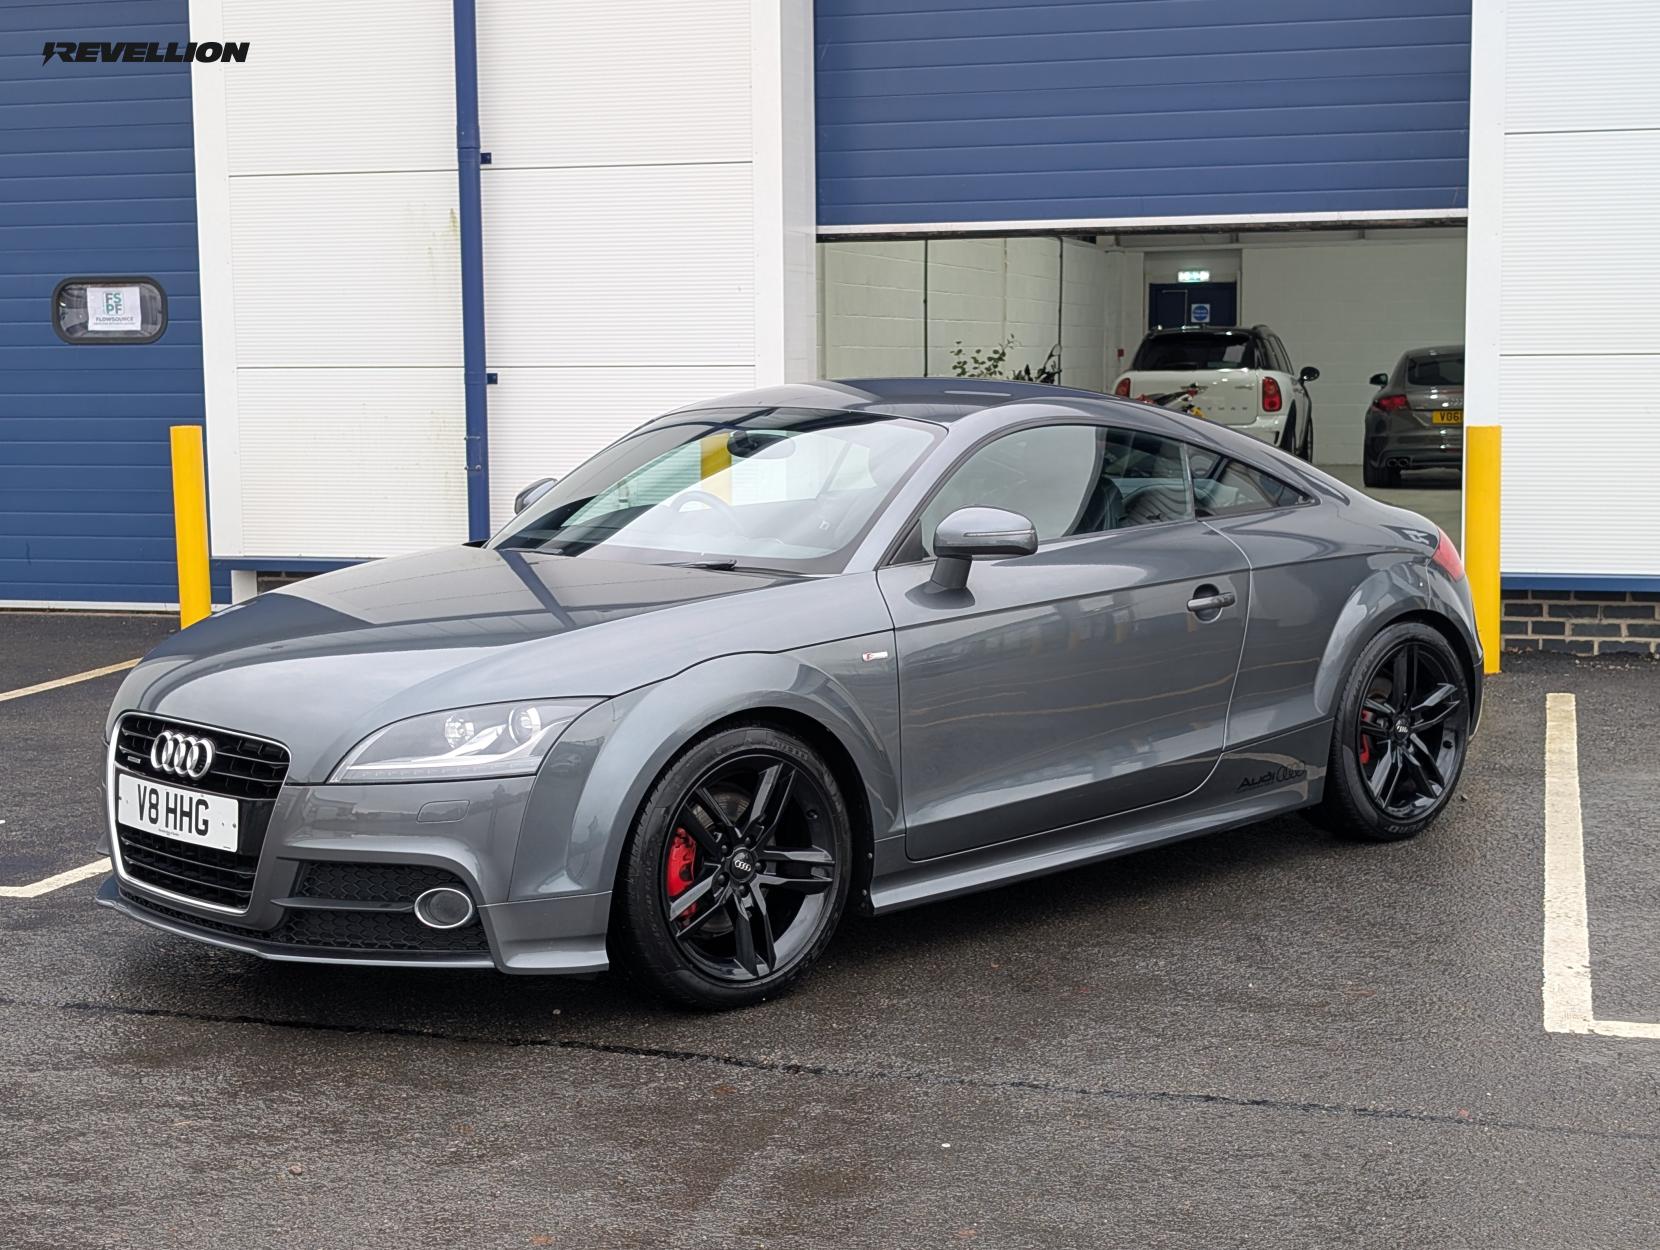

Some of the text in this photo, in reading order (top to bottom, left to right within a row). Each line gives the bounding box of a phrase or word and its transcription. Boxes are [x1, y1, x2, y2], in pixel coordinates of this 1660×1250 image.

[105, 292, 122, 303] FS
[106, 303, 123, 314] PF
[138, 783, 209, 836] V8 HHG
